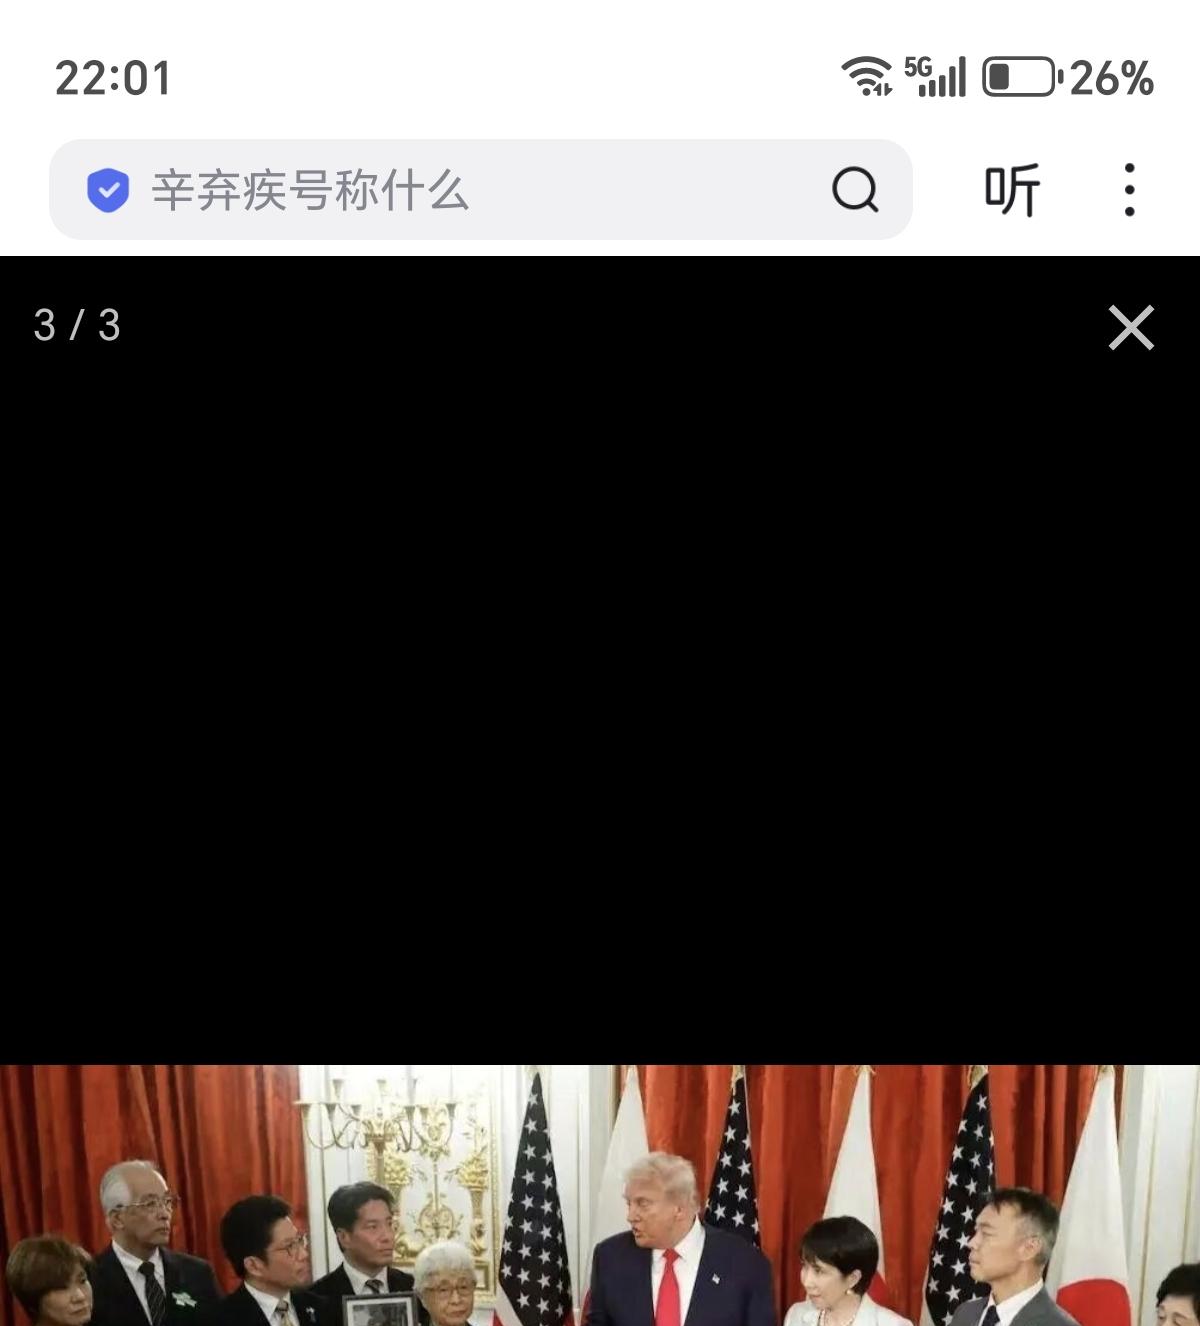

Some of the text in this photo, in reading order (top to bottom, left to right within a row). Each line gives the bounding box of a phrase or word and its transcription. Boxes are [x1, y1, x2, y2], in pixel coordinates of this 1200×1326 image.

[56, 60, 168, 96] 22:01
[905, 56, 933, 77] 5G
[1071, 60, 1155, 96] 26%
[152, 168, 470, 212] 辛弃疾号称什么
[986, 163, 1041, 218] 听
[35, 308, 56, 342] 3
[99, 308, 120, 342] 3
